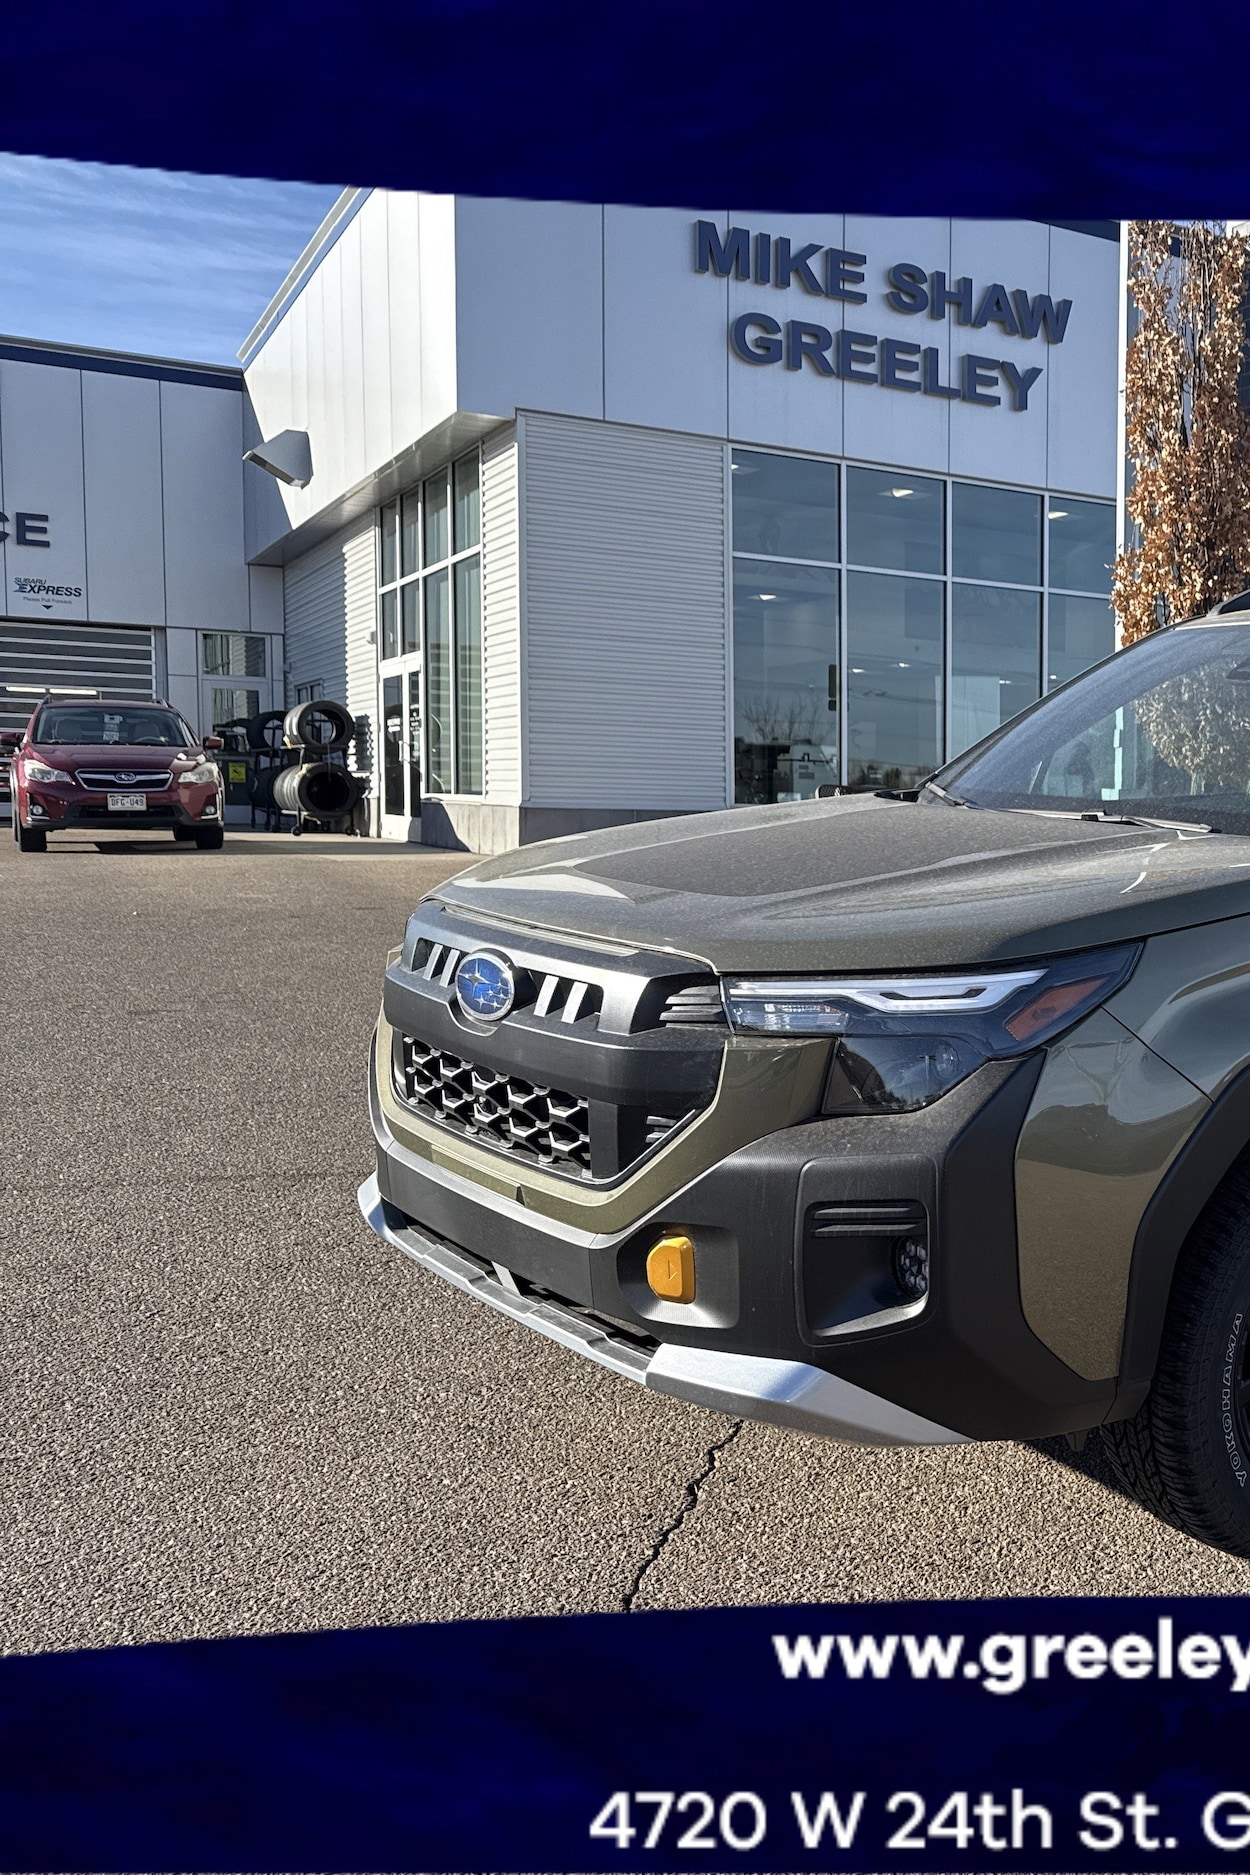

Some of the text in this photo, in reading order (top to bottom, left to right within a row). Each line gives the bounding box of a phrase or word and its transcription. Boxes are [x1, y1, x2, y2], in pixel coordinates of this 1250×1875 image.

[693, 220, 1073, 345] MIKE SHAW
[731, 312, 1043, 412] GREELEY
[13, 582, 82, 598] EXPRESS
[14, 577, 47, 585] SUBARU
[1221, 1313, 1248, 1488] YOKOHAMA
